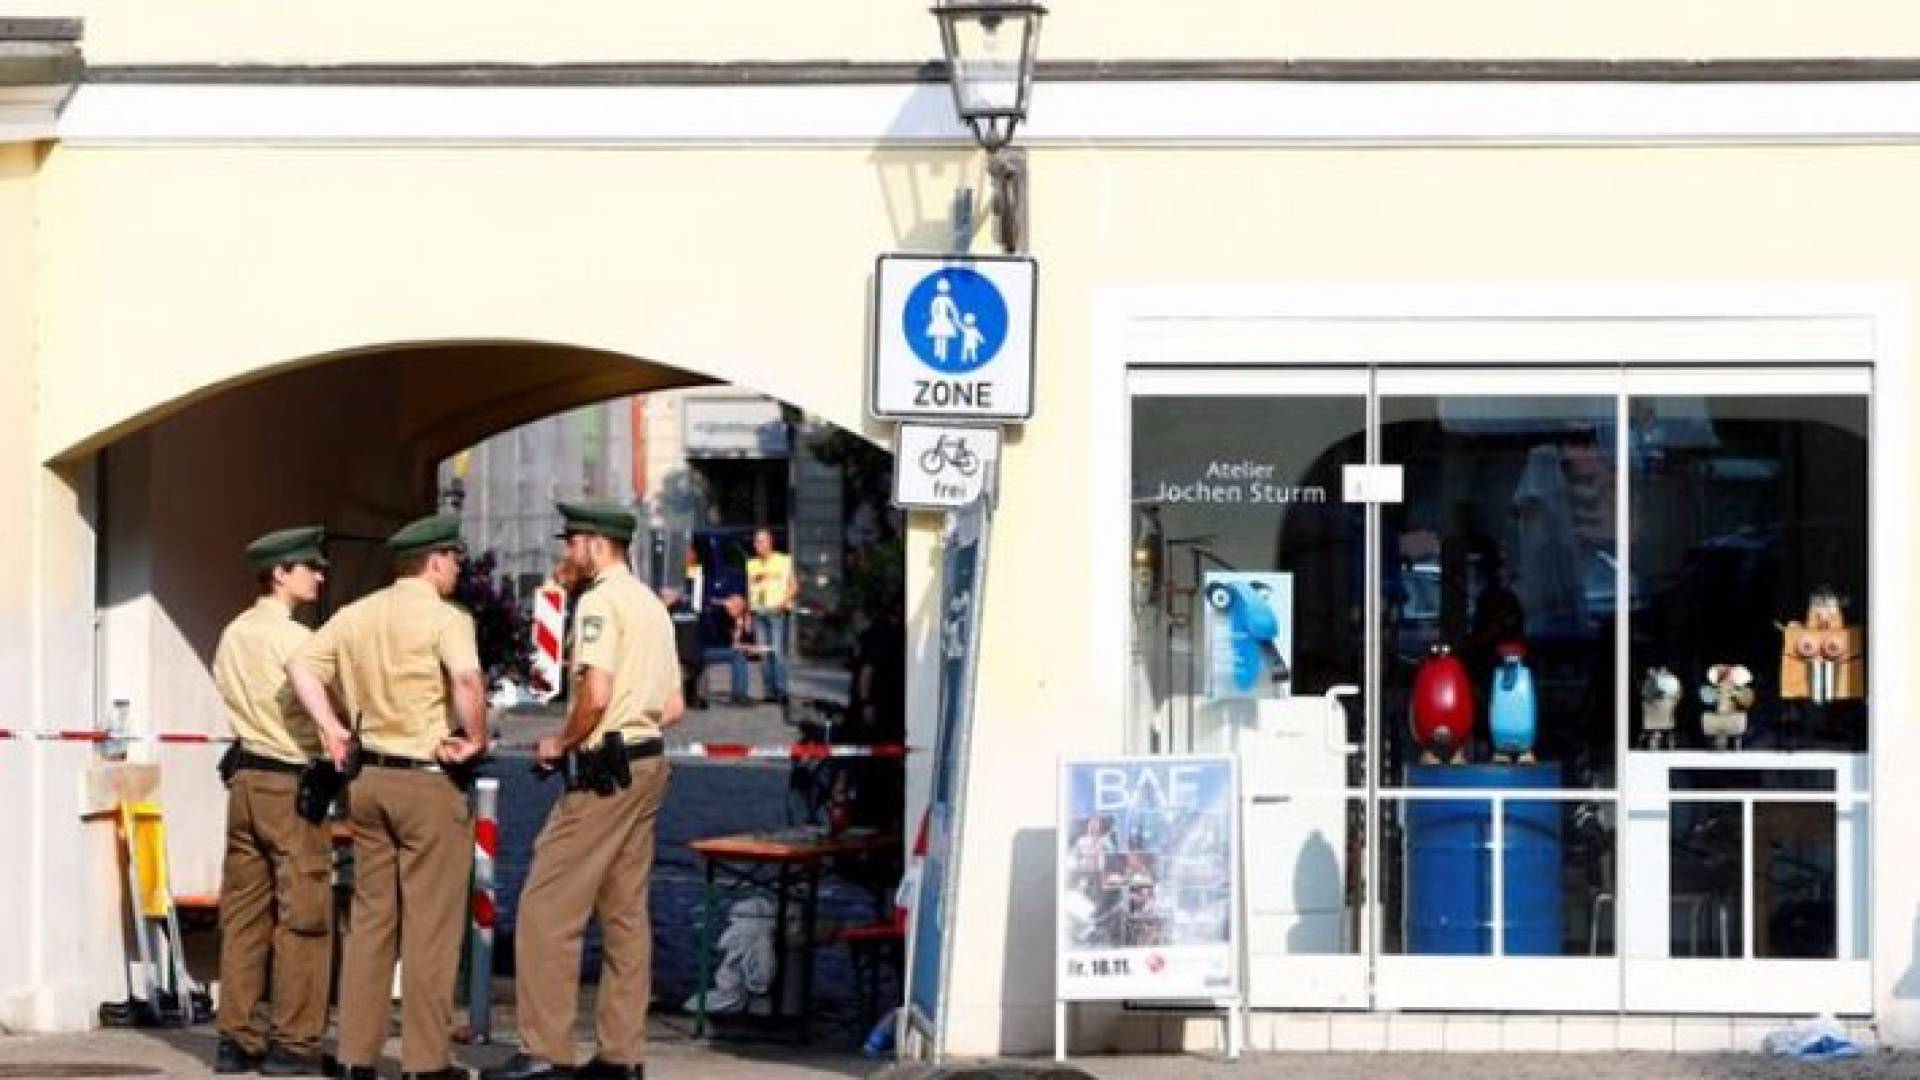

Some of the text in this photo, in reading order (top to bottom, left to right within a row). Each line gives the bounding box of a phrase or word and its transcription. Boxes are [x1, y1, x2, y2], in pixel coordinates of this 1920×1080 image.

[913, 380, 992, 407] ZONE
[1206, 460, 1275, 479] Atelier
[932, 480, 968, 498] frei
[1157, 480, 1327, 503] Jochen Sturm
